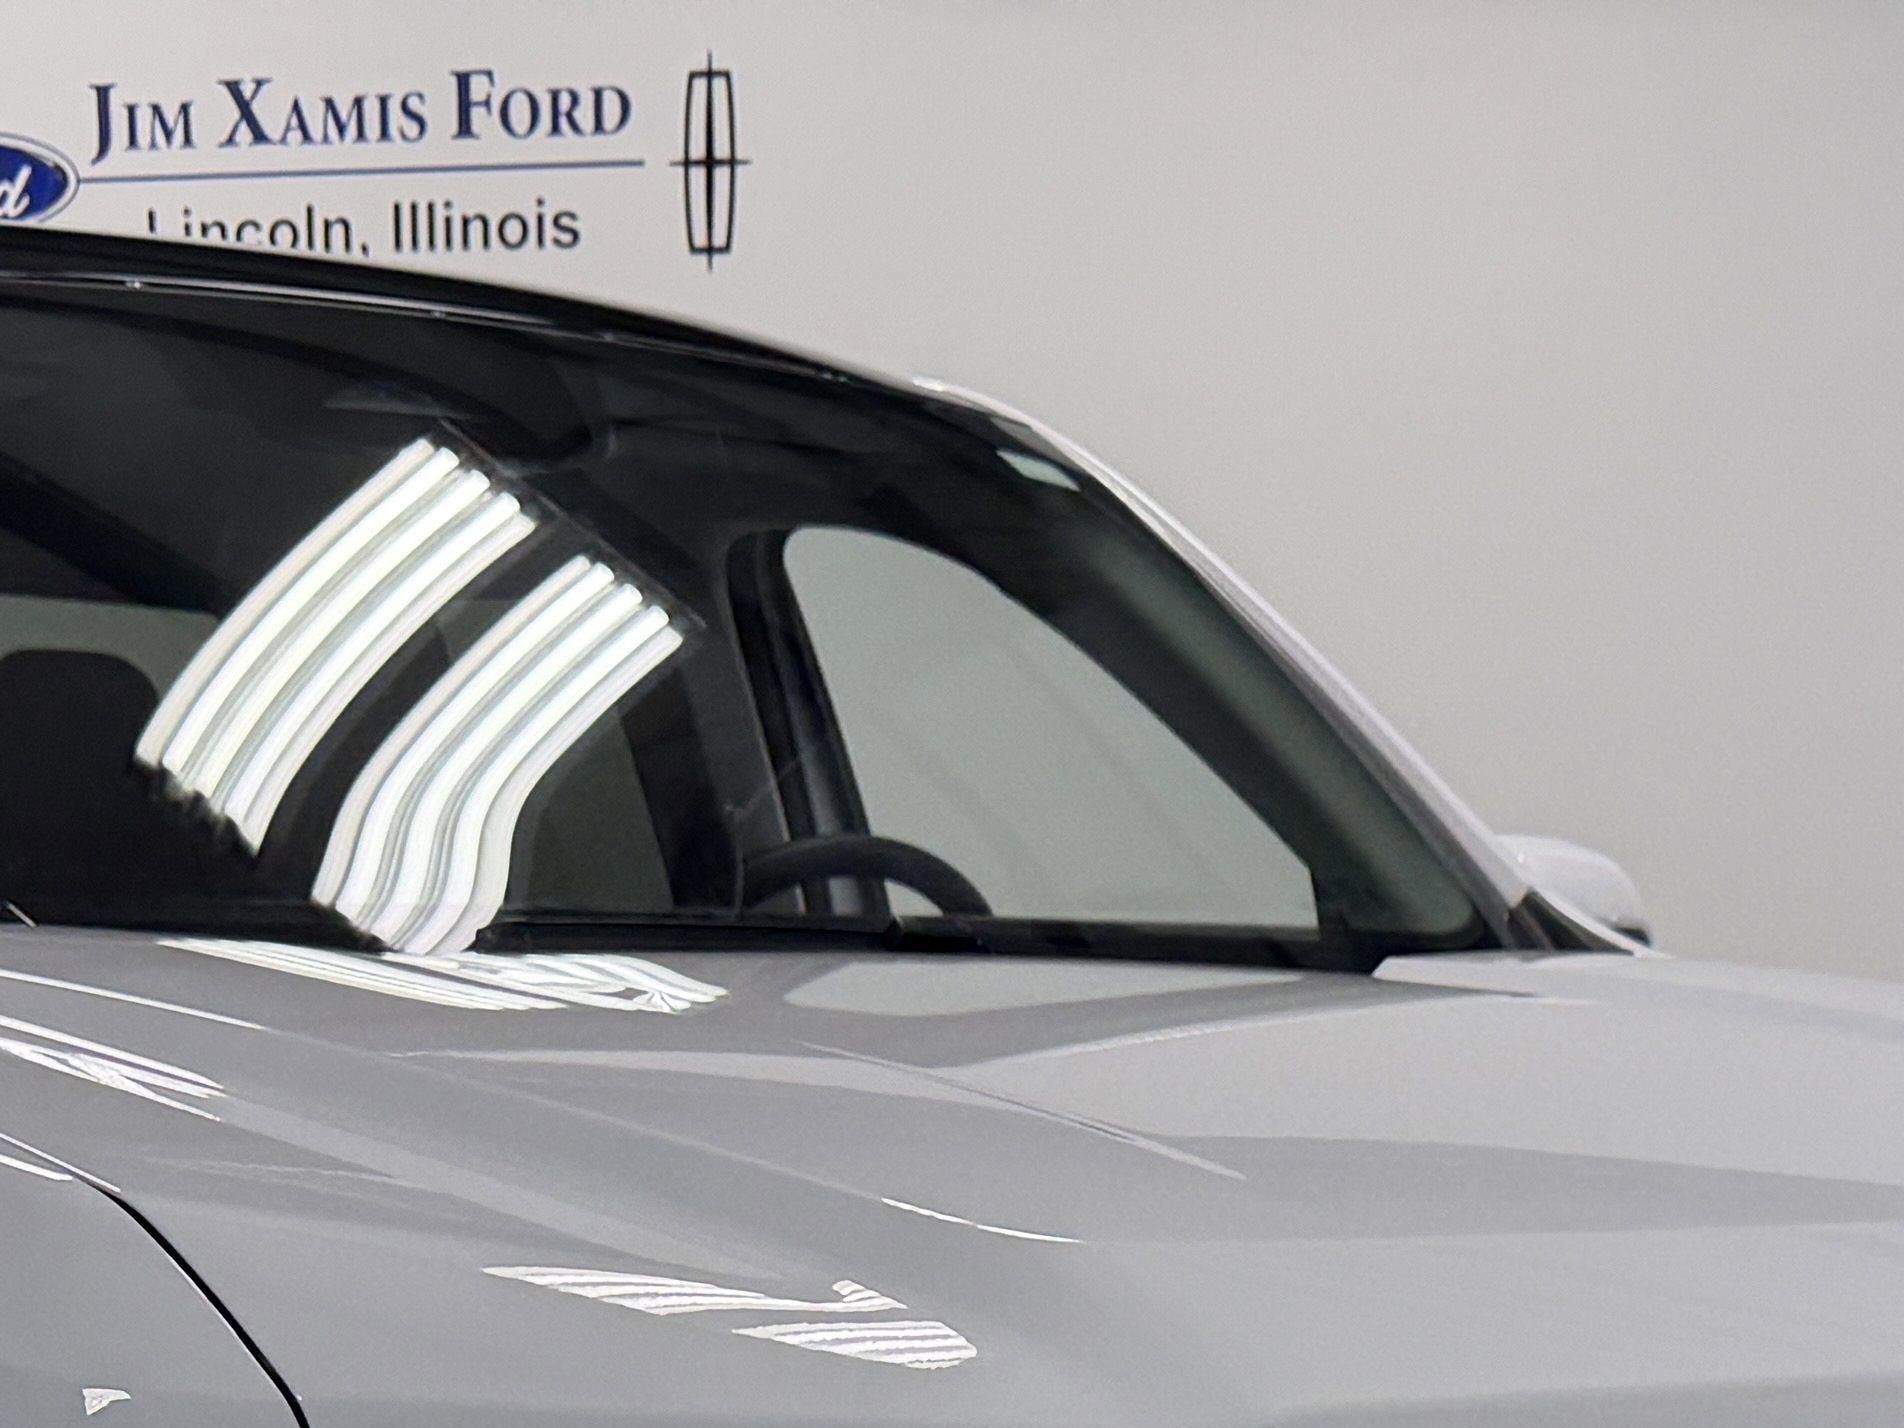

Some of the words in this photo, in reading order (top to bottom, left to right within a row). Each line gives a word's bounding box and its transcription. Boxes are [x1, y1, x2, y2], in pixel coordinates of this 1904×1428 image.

[89, 82, 196, 166] JIM
[218, 77, 428, 148] XAMIS
[451, 69, 632, 139] FORD
[394, 197, 582, 253] Illinois
